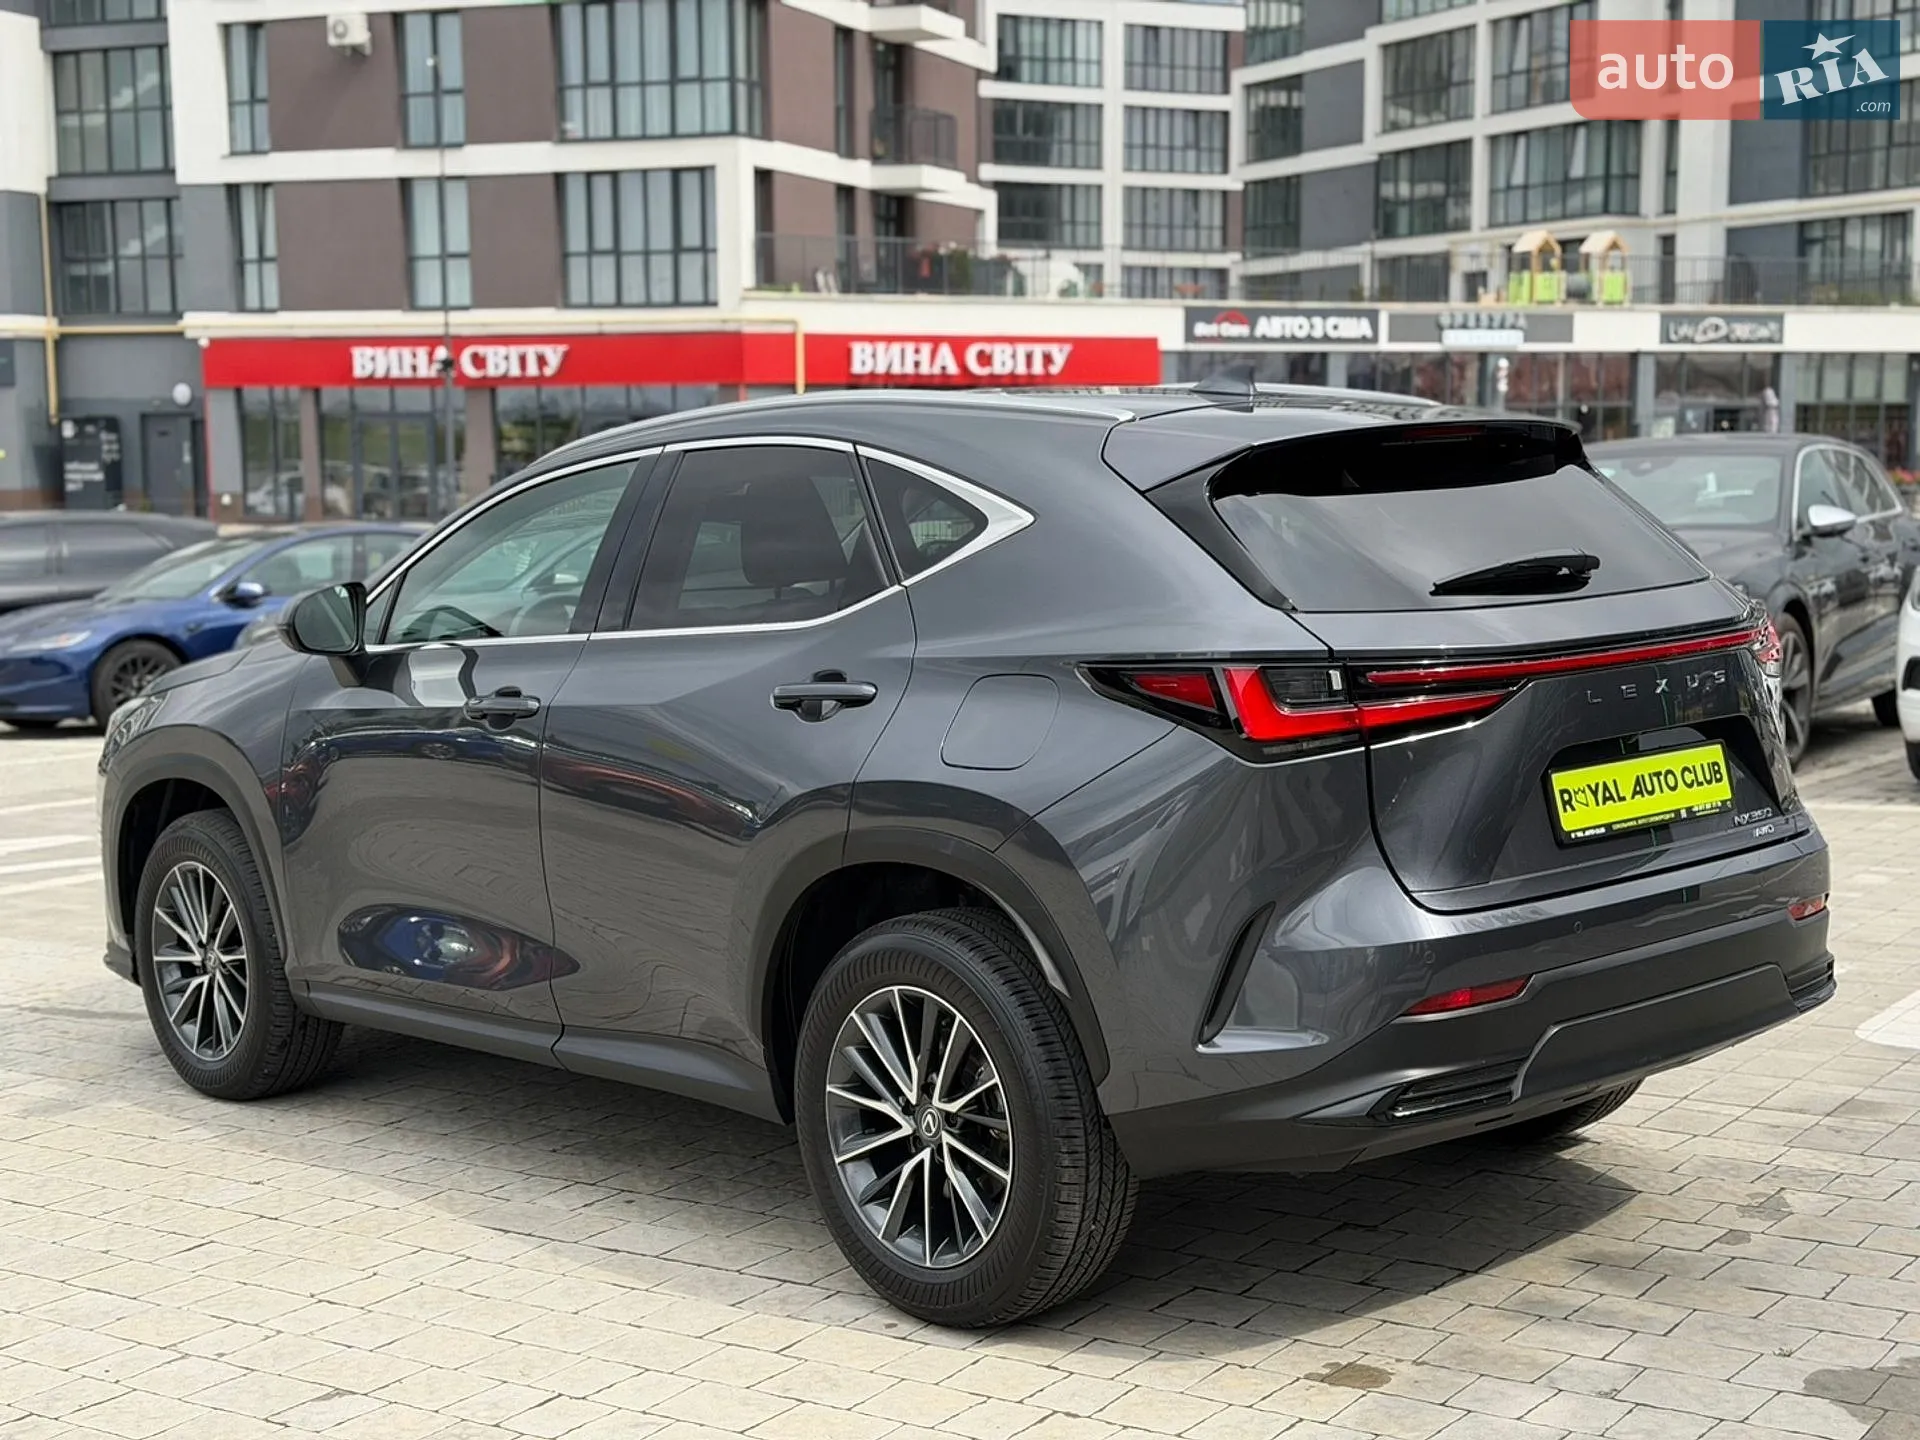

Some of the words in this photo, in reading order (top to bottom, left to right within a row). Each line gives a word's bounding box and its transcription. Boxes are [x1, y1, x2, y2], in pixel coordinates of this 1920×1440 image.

[459, 344, 570, 379] СВІТУ
[849, 341, 960, 375] ВИНА
[964, 341, 1073, 376] СВІТУ
[1586, 670, 1726, 704] LEXUS
[1631, 767, 1679, 800] AUTO
[1680, 761, 1723, 789] CLUB
